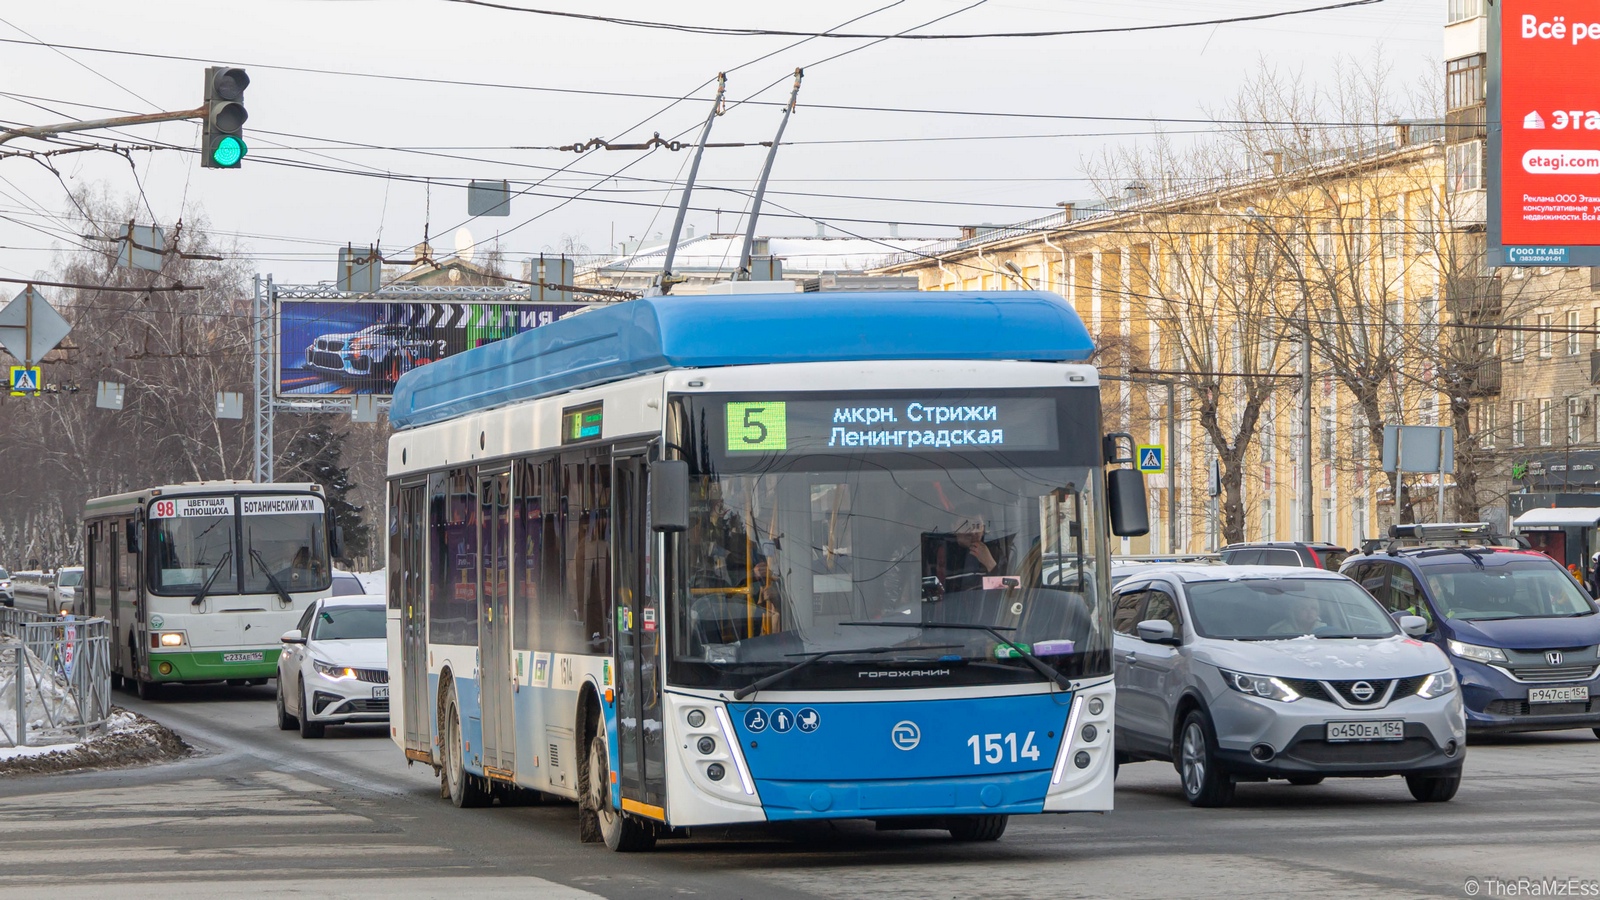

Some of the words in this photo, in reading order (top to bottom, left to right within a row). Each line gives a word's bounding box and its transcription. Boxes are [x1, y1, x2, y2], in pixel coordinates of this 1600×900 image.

[1522, 14, 1566, 39] Всё
[1572, 23, 1600, 45] ре
[1529, 154, 1599, 170] etagi.com
[833, 407, 898, 425] мкрн.
[907, 402, 997, 424] Стрижи
[742, 408, 768, 444] 5
[828, 427, 1003, 447] Ленинградская
[157, 501, 174, 517] 98
[187, 499, 225, 507] ЦВЕТУЩАЯ
[244, 498, 300, 513] БОТАНИЧЕСКИЙ
[183, 507, 229, 516] ПЛЮЩИХА
[560, 658, 573, 685] 1514
[858, 669, 950, 678] ГОРОЖАНИН
[1532, 689, 1570, 700] Р947СЕ
[1571, 688, 1587, 696] 154
[1331, 724, 1380, 737] О450ЕА
[1382, 722, 1401, 733] 154
[967, 731, 1040, 765] 1514
